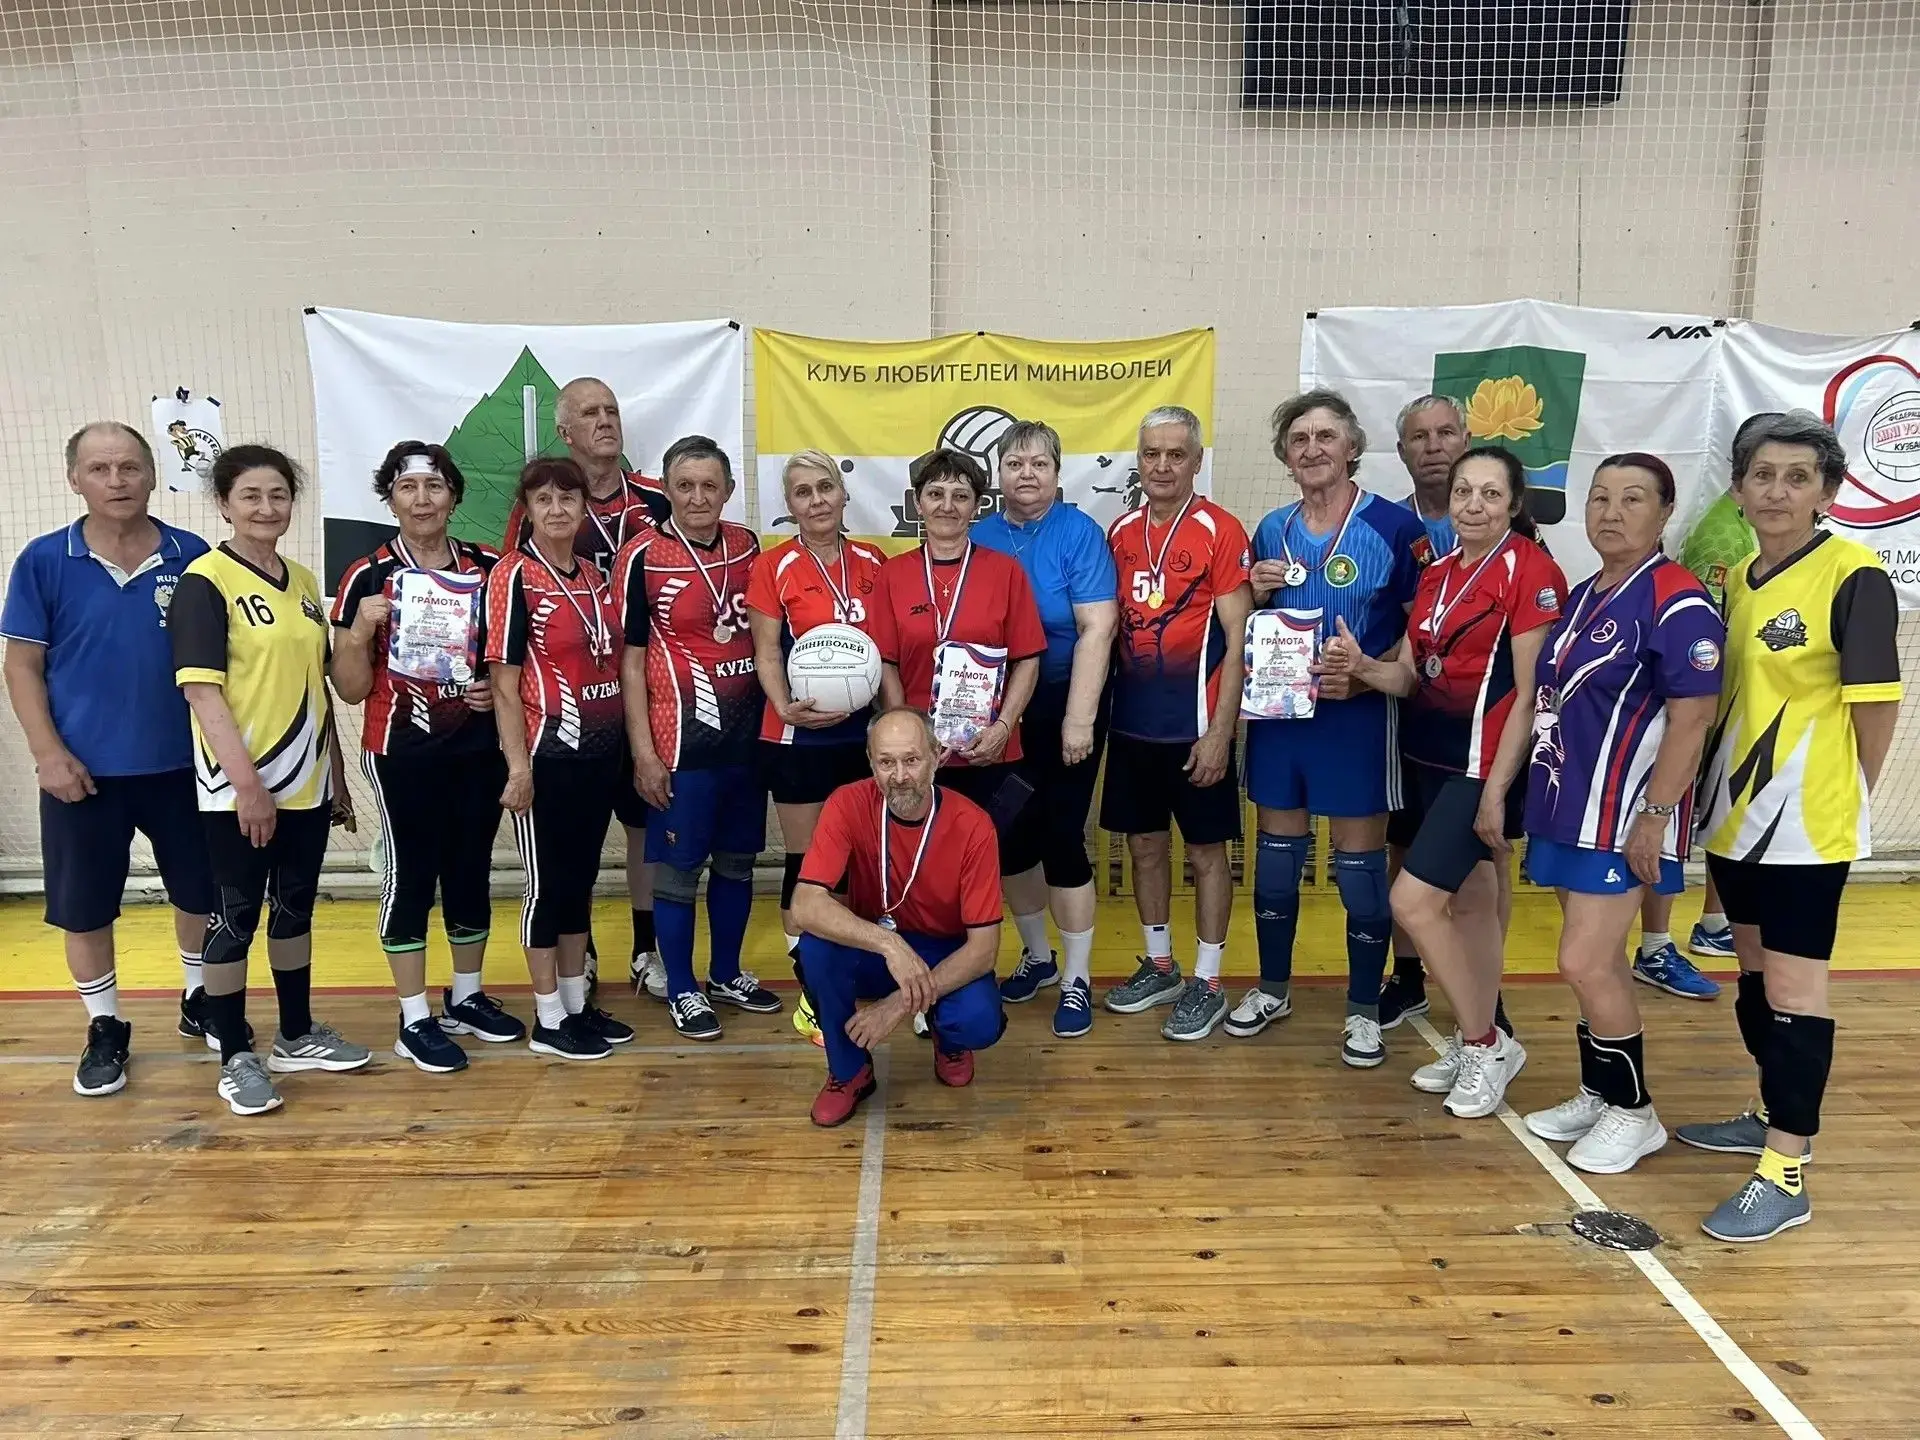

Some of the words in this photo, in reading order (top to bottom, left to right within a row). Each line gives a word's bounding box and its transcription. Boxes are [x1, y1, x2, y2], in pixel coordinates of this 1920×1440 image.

[807, 363, 866, 383] КЛУБ
[1875, 425, 1900, 443] MINI
[1903, 422, 1920, 436] VO
[1894, 441, 1920, 451] КУЗБА
[1877, 550, 1891, 564] Я
[1896, 550, 1920, 564] МИ
[156, 575, 179, 583] RUS
[1291, 567, 1300, 579] 2
[1889, 569, 1920, 584] АС
[411, 595, 461, 607] ГРАМОТА
[236, 594, 275, 626] 16
[795, 640, 865, 655] МИНИВОЛЕЙ
[1261, 637, 1304, 646] ГРАМОТА
[715, 657, 755, 678] КУZБ
[1430, 658, 1437, 671] 2
[949, 670, 989, 680] ГРАМОТА
